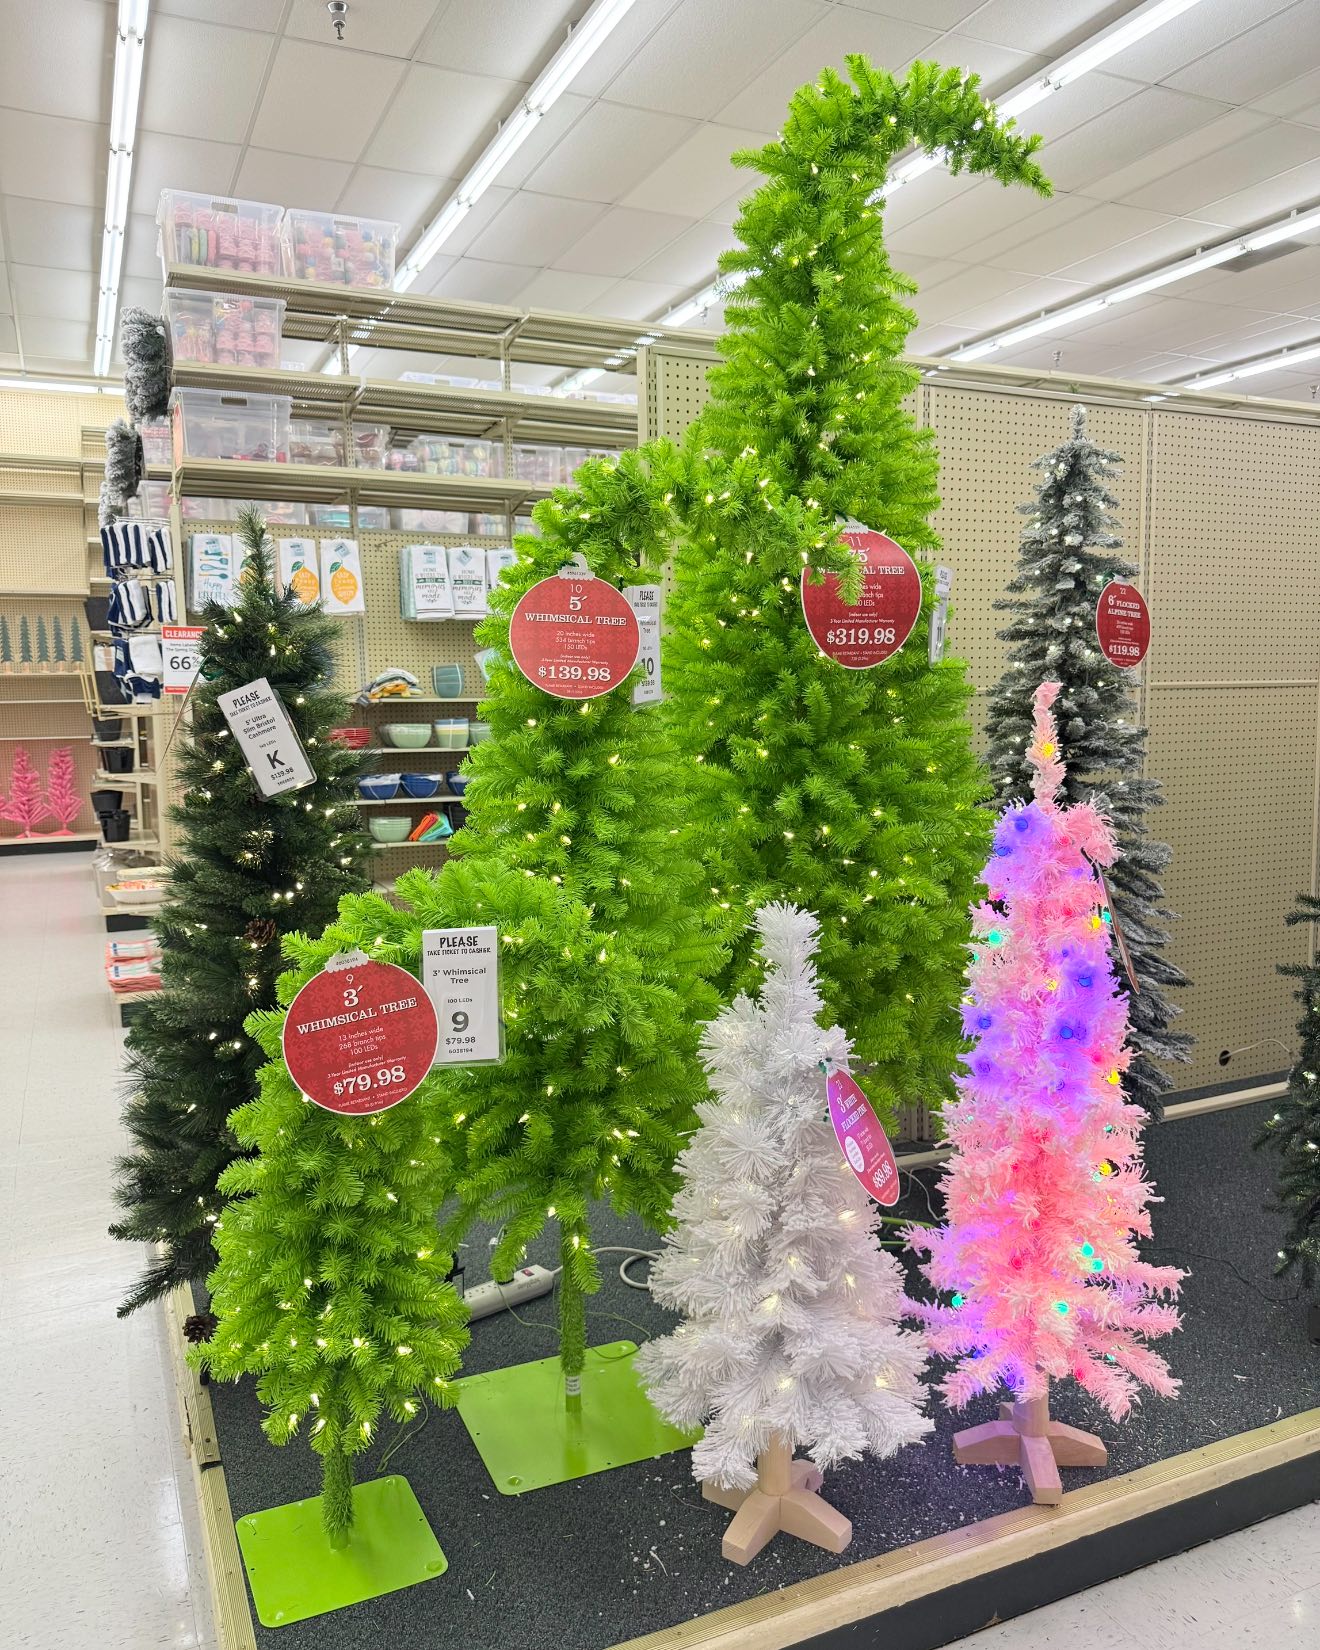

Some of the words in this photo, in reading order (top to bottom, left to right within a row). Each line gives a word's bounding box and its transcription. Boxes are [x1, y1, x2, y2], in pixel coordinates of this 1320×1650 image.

[850, 536, 862, 546] 11
[878, 566, 905, 575] TREE
[570, 584, 582, 593] 10
[569, 596, 588, 611] 5'
[525, 613, 592, 624] WHIMSICAL
[595, 616, 627, 626] TREE
[165, 630, 203, 638] CLEARANC
[827, 628, 896, 645] $319.98
[1108, 644, 1140, 657] $119.98
[641, 657, 654, 675] 10
[538, 665, 611, 682] $139.98
[232, 690, 260, 708] PLEASE
[252, 714, 267, 722] Ultra
[256, 717, 276, 728] Bristol
[266, 750, 286, 769] K
[440, 936, 478, 948] PLEASE
[443, 968, 486, 976] Whimsical
[346, 974, 353, 984] 9
[343, 985, 363, 1007] 3'
[296, 1008, 377, 1035] WHIMSICAL
[380, 997, 418, 1015] TREE
[451, 1011, 469, 1032] 9
[348, 1030, 367, 1039] inches
[353, 1037, 374, 1046] branch
[446, 1037, 476, 1045] $79.98
[364, 1044, 378, 1052] LEDs
[333, 1065, 406, 1096] $79.98
